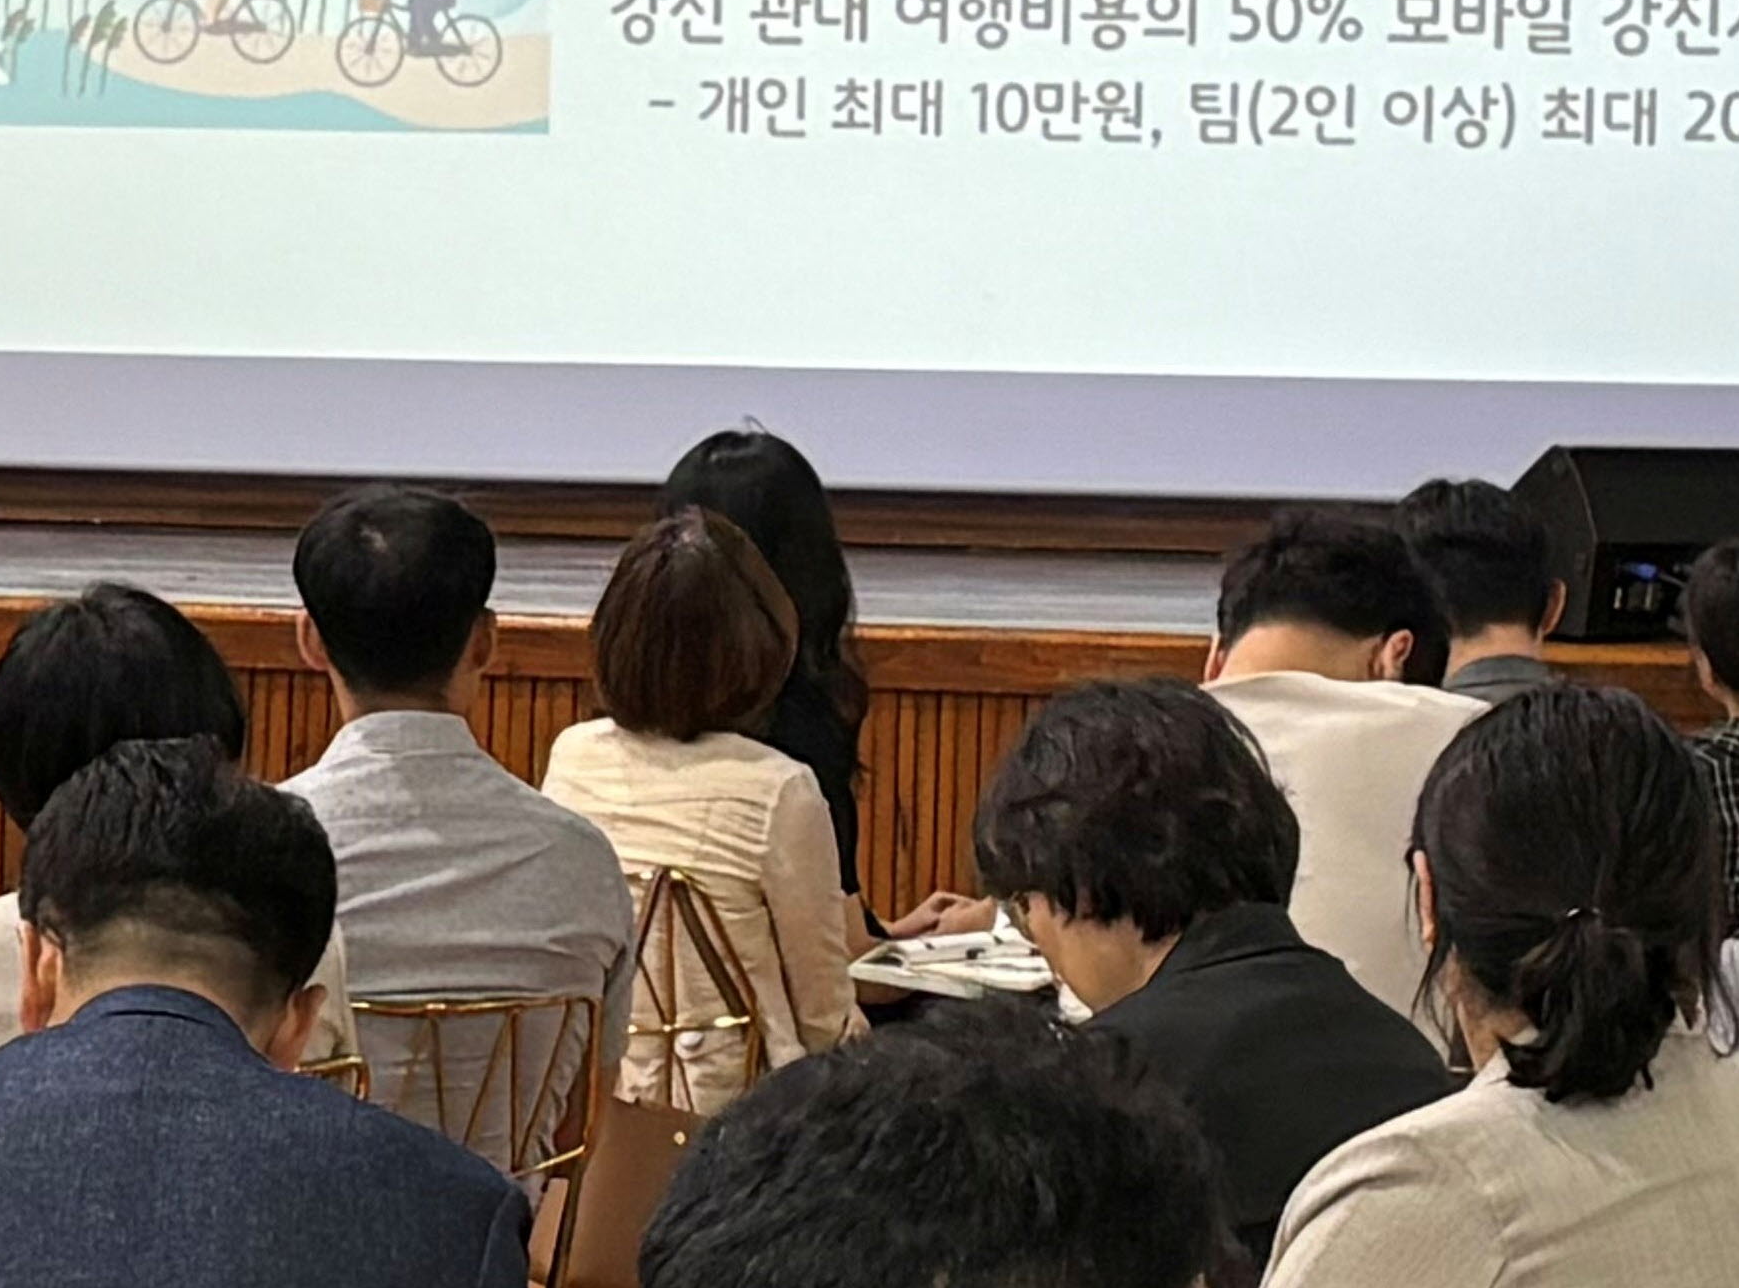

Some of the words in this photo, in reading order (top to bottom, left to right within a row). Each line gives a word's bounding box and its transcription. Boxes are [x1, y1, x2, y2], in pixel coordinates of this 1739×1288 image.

[699, 77, 806, 138] 개인
[832, 79, 943, 137] 최대
[972, 81, 1161, 147] 10만원,
[1191, 80, 1355, 145] 팀(2인
[1384, 83, 1515, 149] 이상)
[1542, 87, 1657, 146] 최대
